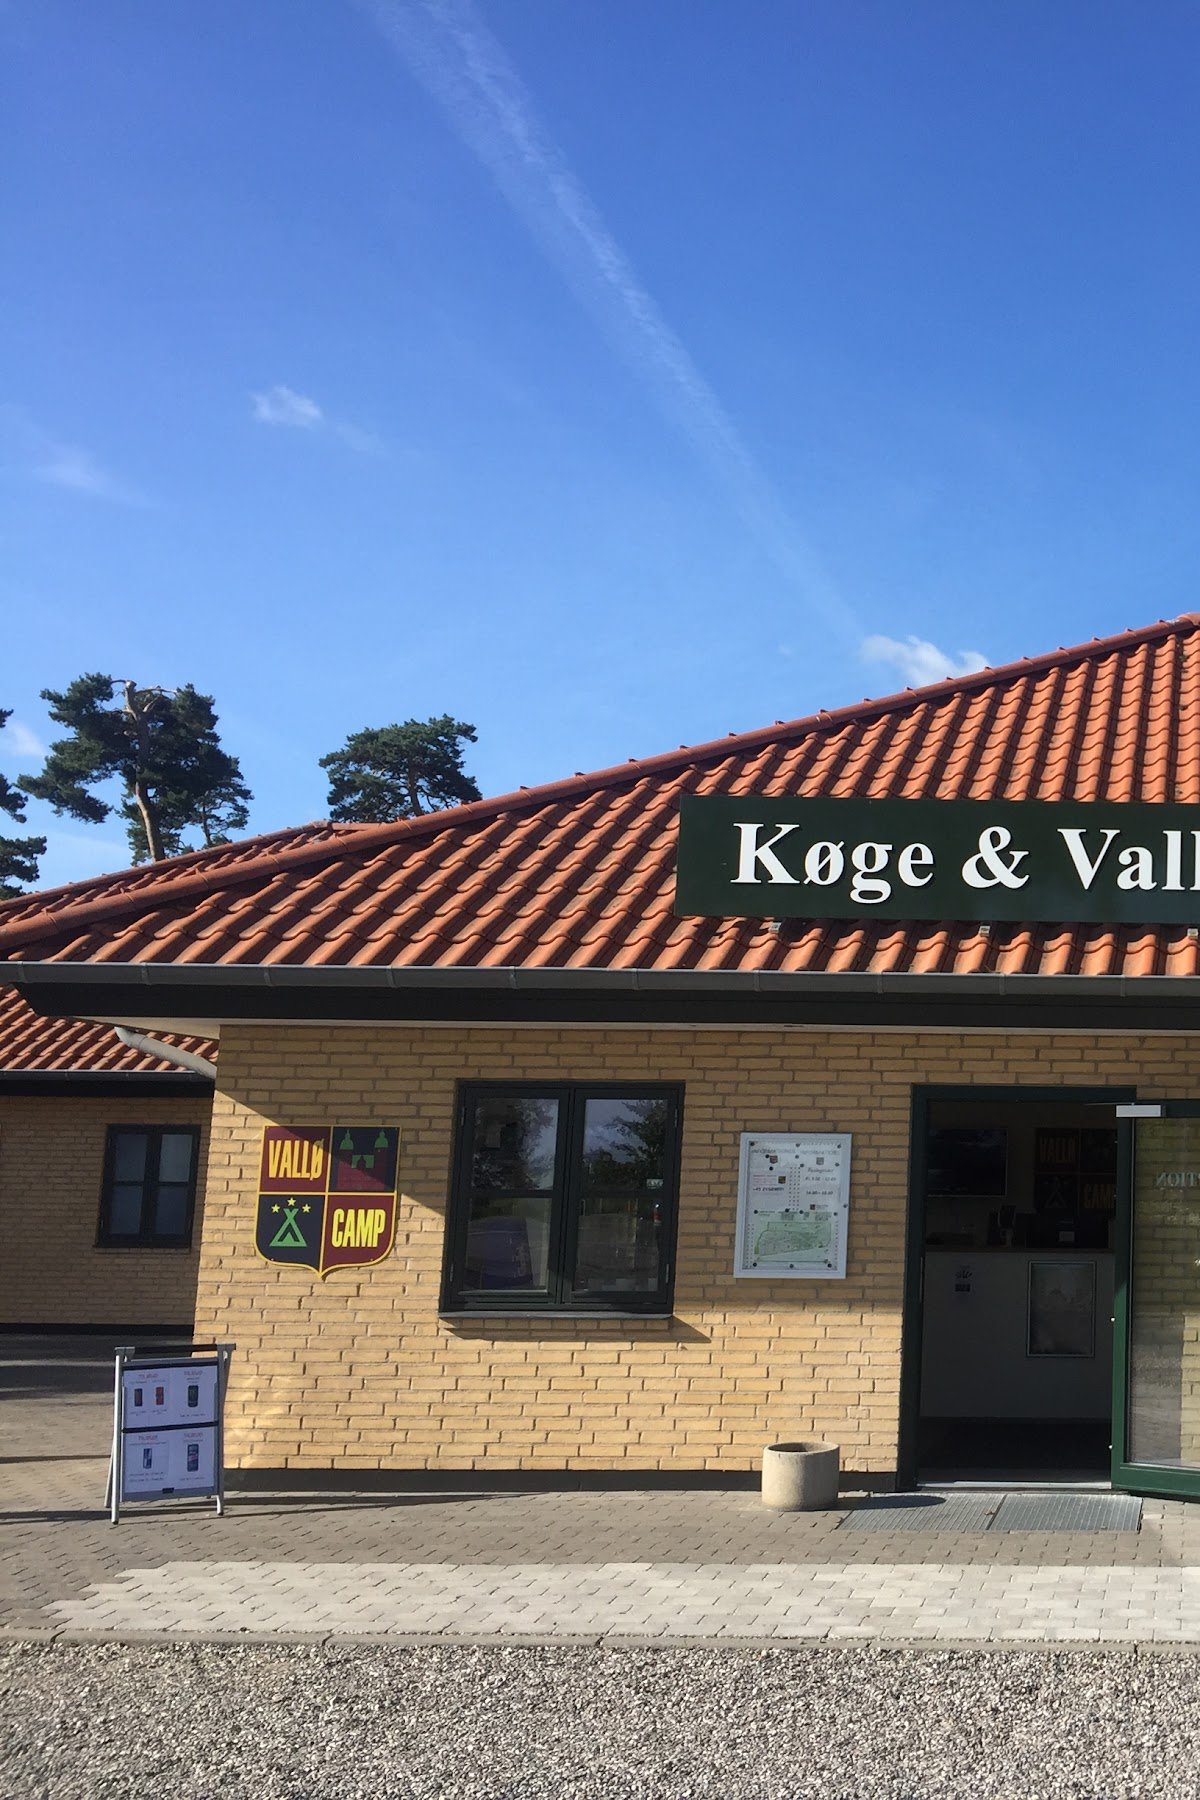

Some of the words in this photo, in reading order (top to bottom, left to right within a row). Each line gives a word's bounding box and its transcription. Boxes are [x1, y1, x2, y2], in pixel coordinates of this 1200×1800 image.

[730, 823, 934, 904] Køge
[961, 826, 1029, 889] &
[268, 1138, 324, 1181] VALLØ
[1083, 1184, 1114, 1208] CAM
[331, 1208, 386, 1248] CAMP
